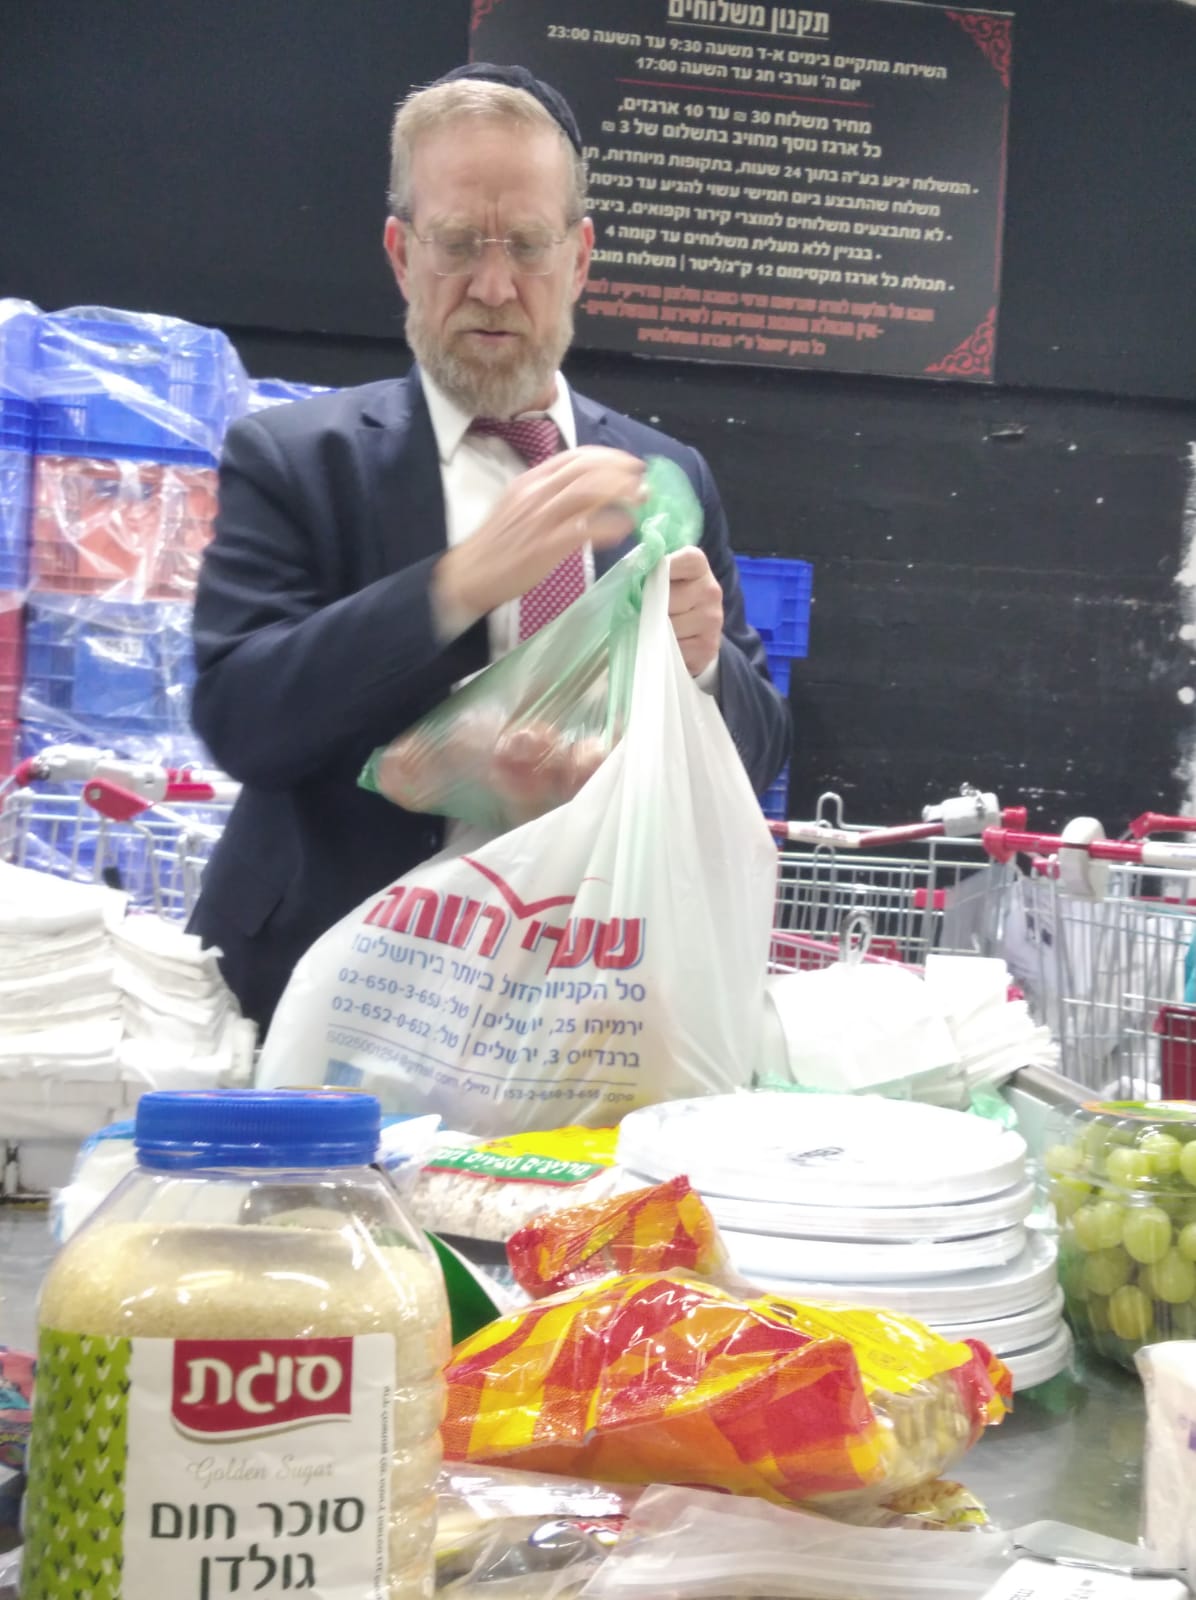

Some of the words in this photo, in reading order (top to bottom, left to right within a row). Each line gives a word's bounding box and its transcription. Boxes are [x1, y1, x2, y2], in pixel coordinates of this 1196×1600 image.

[668, 0, 765, 27] משלוחים
[771, 7, 829, 37] תקנון
[547, 25, 590, 39] 23:00
[593, 29, 641, 46] השעה
[645, 35, 666, 49] עד
[670, 38, 702, 52] 9:30
[705, 42, 753, 59] משעה
[635, 57, 677, 71] 17:00
[788, 51, 831, 66] בימים
[834, 56, 890, 74] מתקיים
[680, 60, 728, 78] השעה
[731, 65, 752, 80] עד
[755, 68, 775, 82] חג
[892, 61, 947, 79] השירות
[778, 71, 818, 87] וערבי
[839, 77, 861, 91] יום
[618, 97, 680, 114] ארגזים,
[683, 103, 704, 117] 10
[707, 106, 730, 120] עד
[733, 111, 747, 122] ₪
[751, 110, 771, 124] 30
[774, 111, 829, 130] משלוח
[602, 120, 616, 132] ₪
[619, 120, 629, 133] 3
[633, 118, 658, 136] של
[663, 124, 728, 143] בתשלום
[832, 119, 872, 134] מחיר
[732, 133, 778, 148] מחויב
[782, 137, 818, 153] נוסף
[821, 140, 859, 156] ארגז
[602, 148, 665, 165] מיוחדות,
[862, 141, 882, 158] כל
[667, 153, 732, 173] בתקופות
[735, 161, 780, 177] שעות,
[590, 172, 633, 187] כניסת
[783, 166, 802, 179] 24
[805, 167, 839, 183] בתוך
[636, 176, 656, 189] עד
[660, 178, 703, 194] להגיע
[706, 183, 740, 198] עשוי
[912, 176, 971, 194] המשלוח
[743, 187, 788, 202] חמישי
[792, 191, 821, 206] ביום
[824, 194, 889, 211] שהתבצע
[693, 207, 731, 225] קירור
[892, 199, 940, 216] משלוח
[734, 210, 783, 227] למוצרי
[786, 215, 850, 233] משלוחים
[605, 225, 615, 237] 4
[618, 226, 656, 244] קומה
[660, 229, 680, 242] עד
[853, 223, 921, 240] מתבצעים
[924, 228, 944, 242] לא
[683, 232, 749, 250] משלוחים
[752, 236, 799, 254] מעלית
[802, 242, 830, 256] ללא
[590, 249, 623, 264] מוגב
[626, 251, 677, 268] משלוח
[833, 245, 873, 261] בבניין
[756, 264, 773, 277] 12
[776, 264, 841, 285] מקסימום
[844, 271, 878, 286] ארגז
[880, 272, 898, 287] כל
[901, 274, 946, 291] תכולת
[363, 886, 512, 960] רווחה
[352, 933, 445, 974] בירושלים!
[452, 961, 495, 992] ביותר
[499, 973, 543, 1003] הזול
[616, 978, 645, 1001] סל
[550, 1018, 576, 1035] 25,
[584, 1019, 643, 1036] ירמיהו
[473, 1041, 538, 1064] ירשלים
[543, 1049, 560, 1065] 3,
[567, 1049, 640, 1067] ברנדייס
[181, 1350, 343, 1413] סוגת
[186, 1456, 267, 1488] Golden
[275, 1454, 335, 1488] Sugar
[150, 1501, 236, 1540] חום
[256, 1497, 365, 1538] סוכר
[199, 1542, 316, 1600] גולדן
